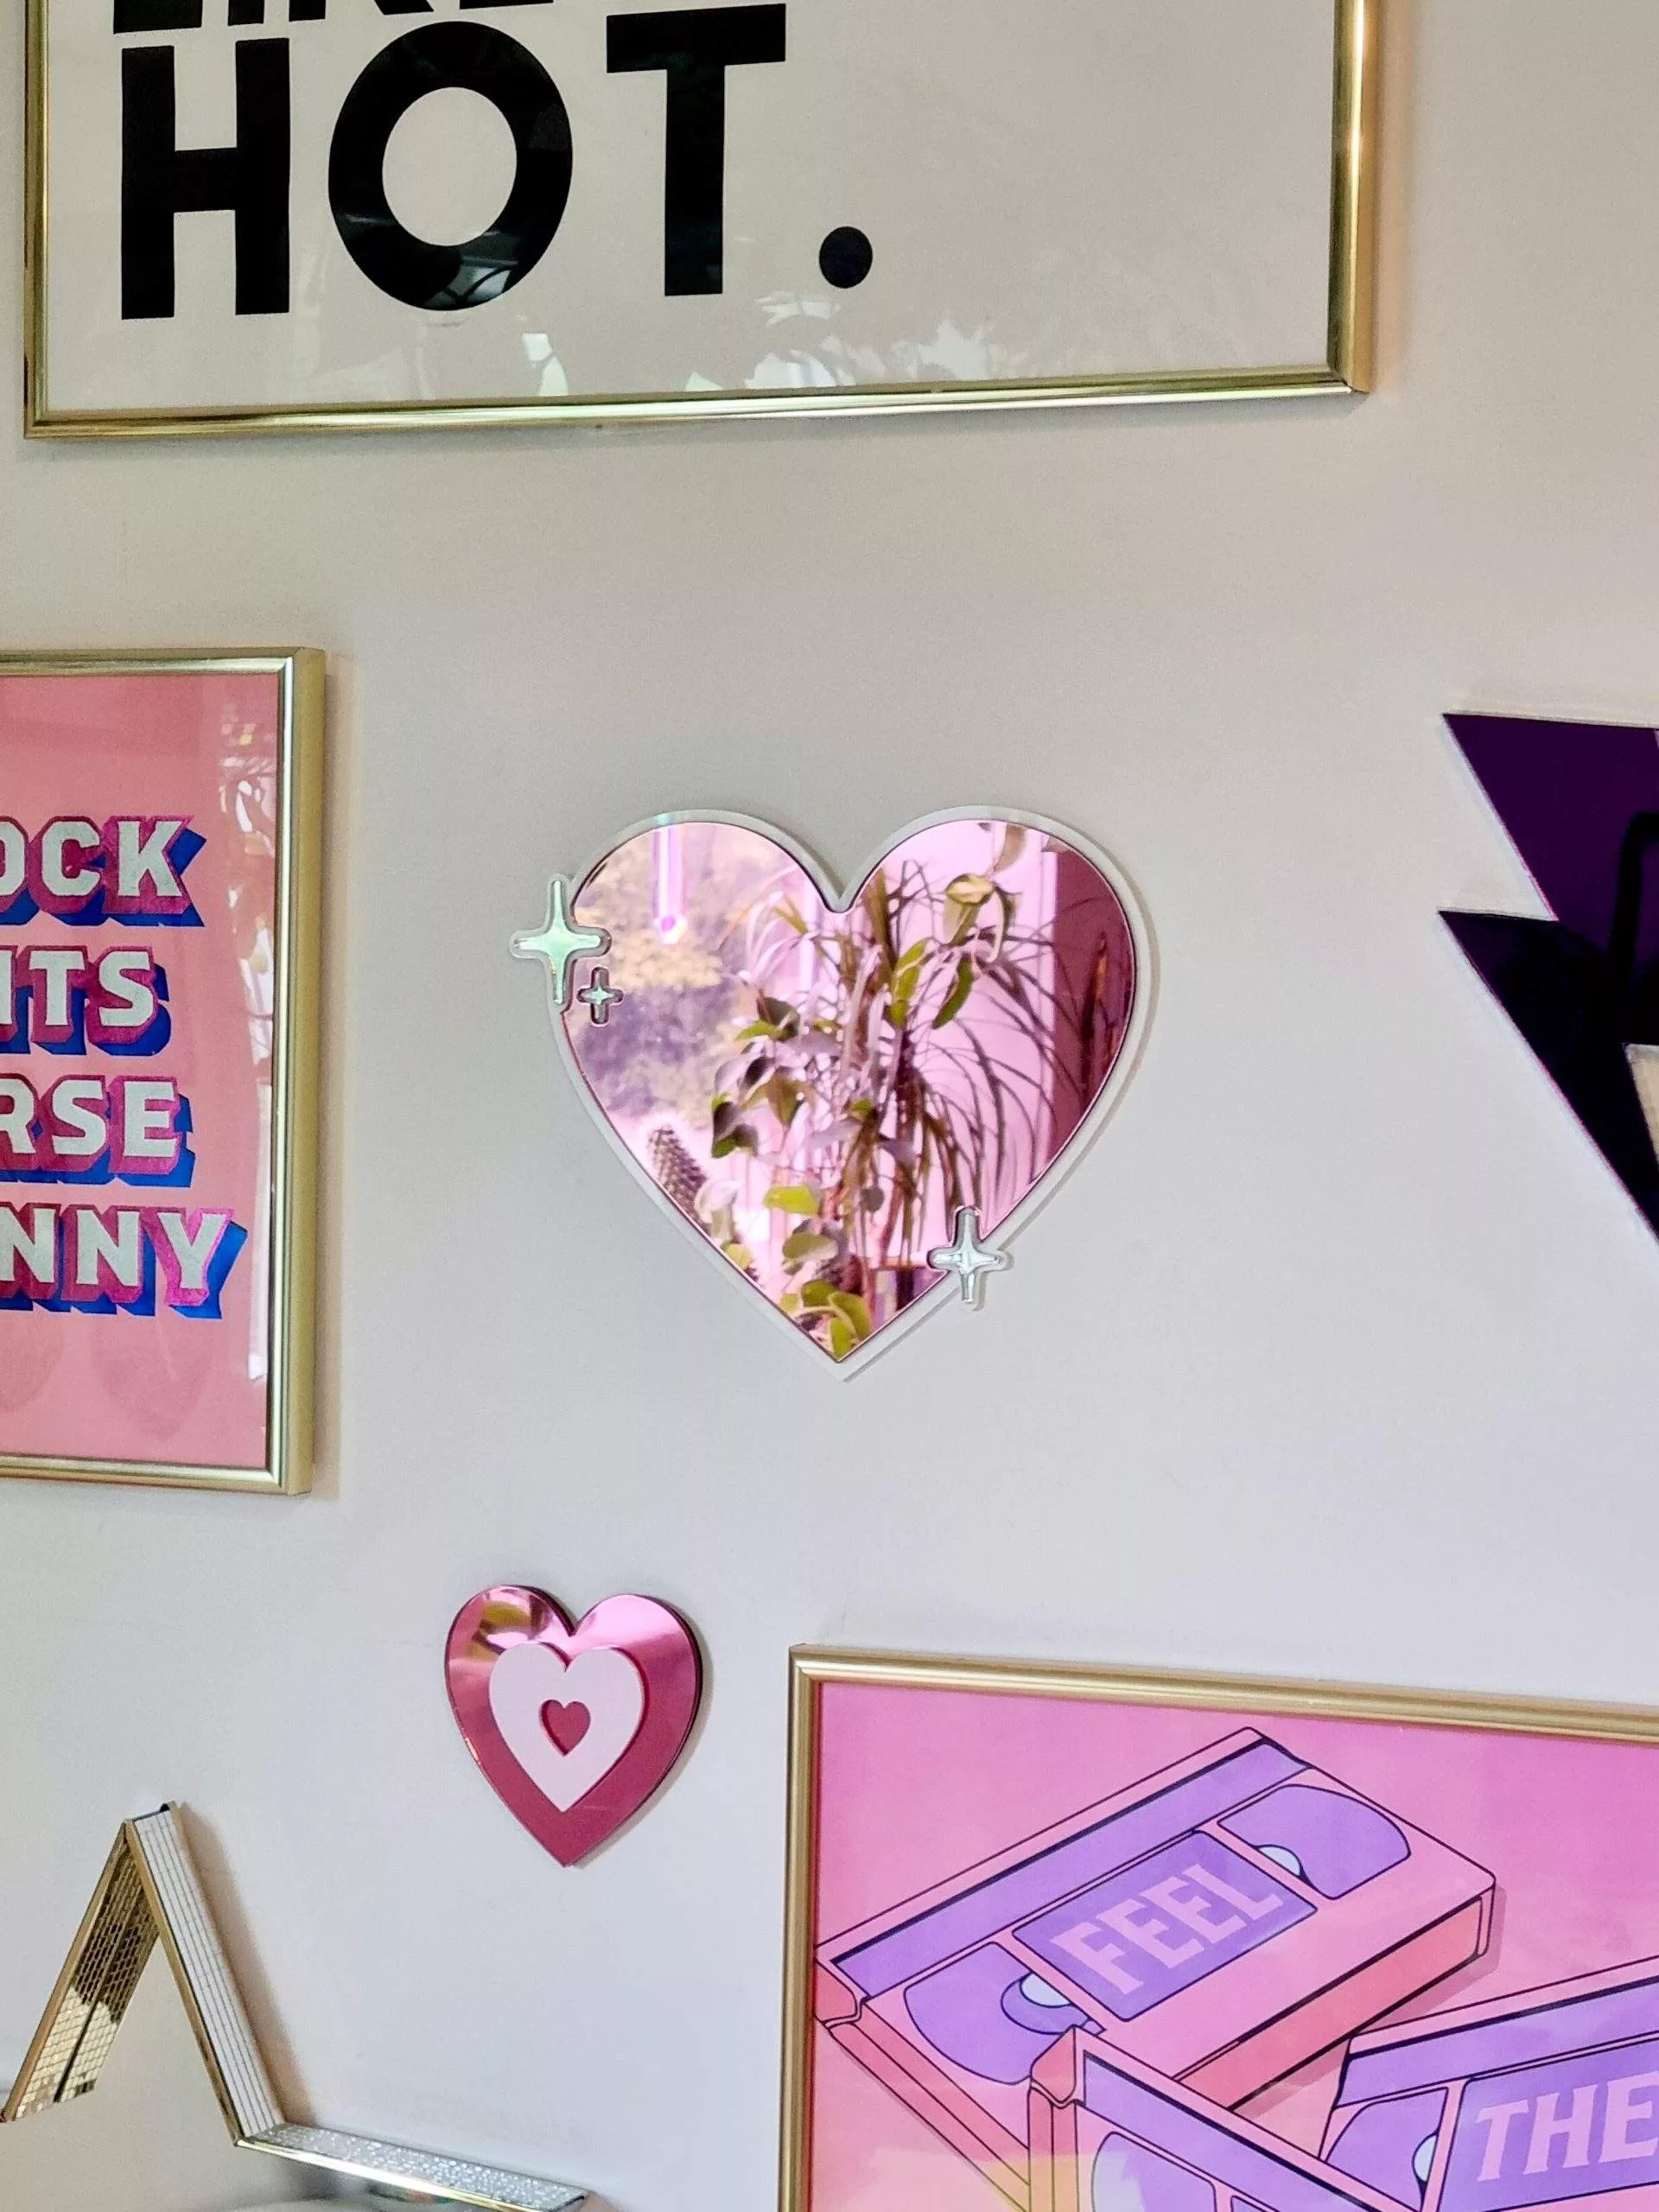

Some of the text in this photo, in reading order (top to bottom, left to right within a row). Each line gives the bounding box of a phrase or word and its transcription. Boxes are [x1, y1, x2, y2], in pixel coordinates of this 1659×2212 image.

[121, 3, 874, 321] HOT.
[0, 1203, 235, 1308] NNY
[1049, 1864, 1284, 1995] FEEL
[1476, 2070, 1659, 2183] THE
